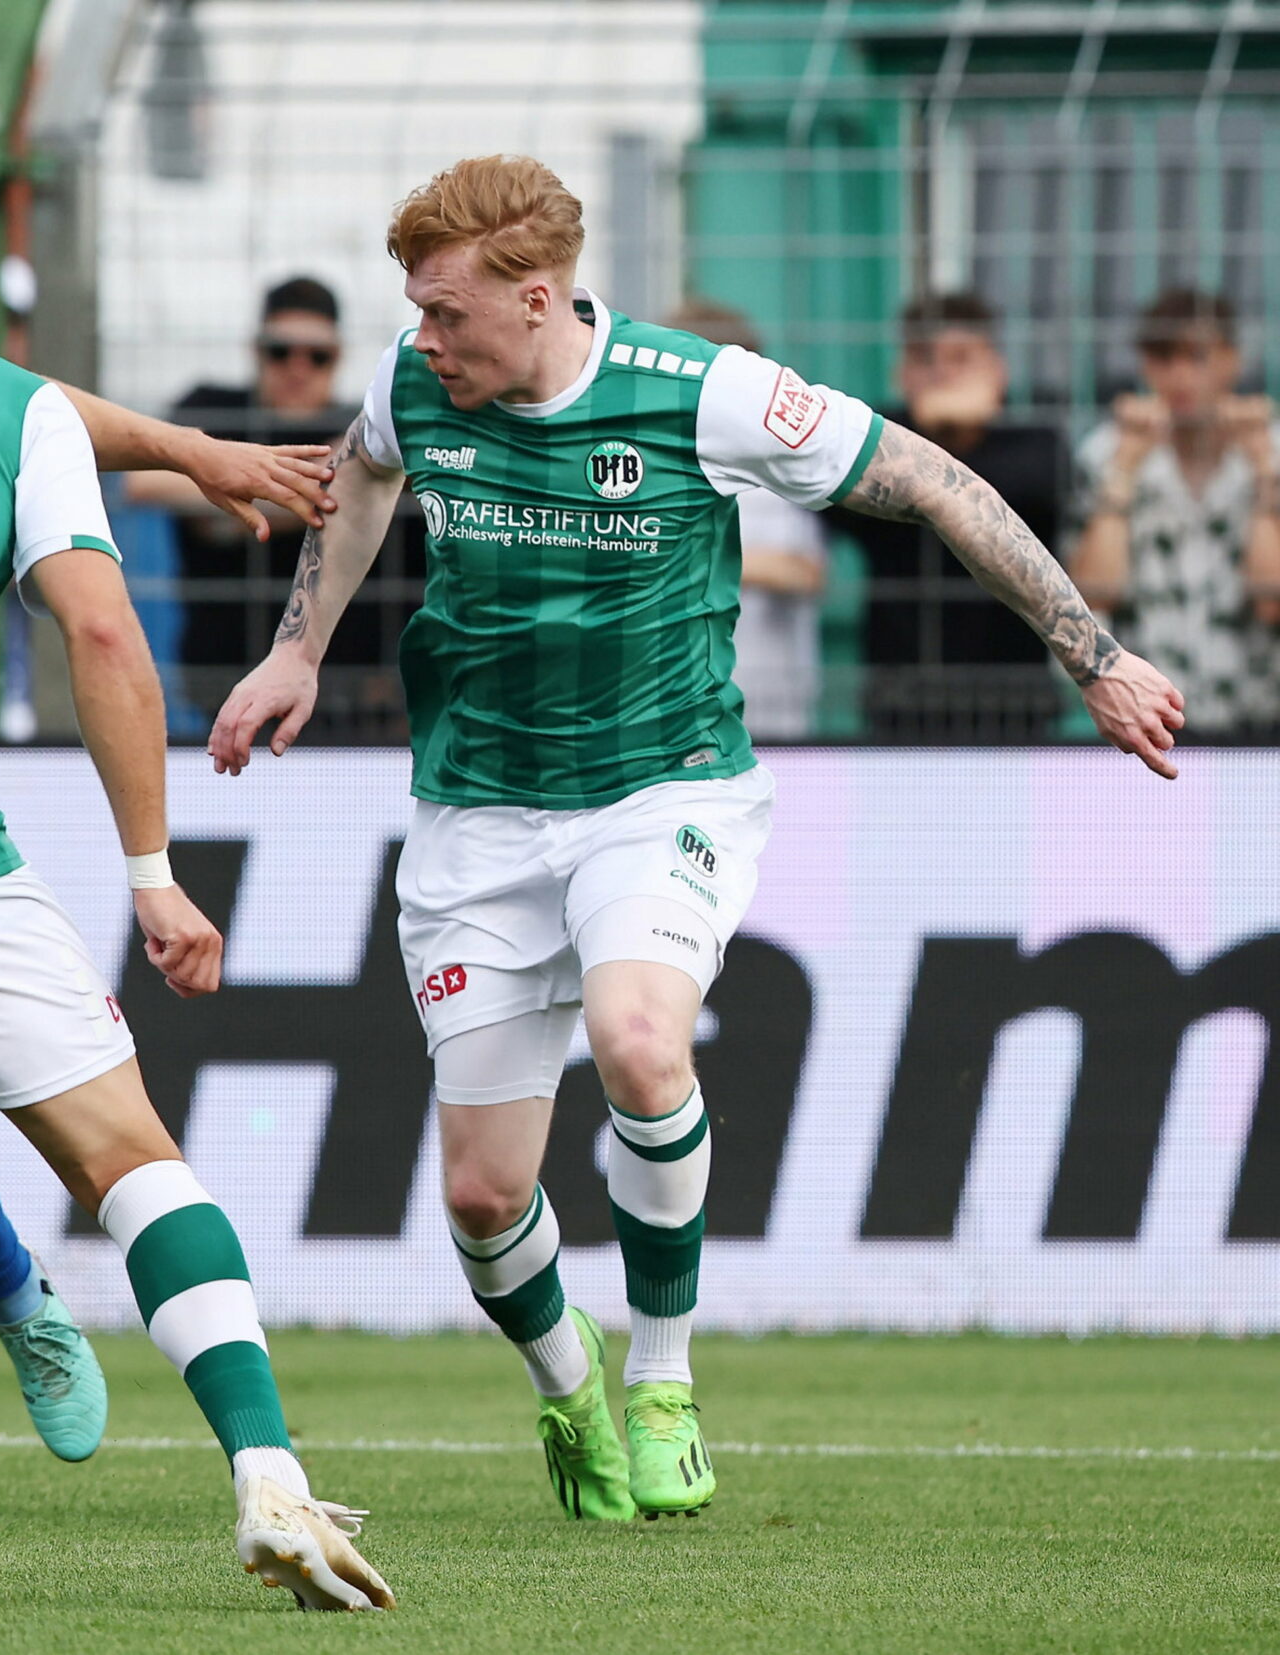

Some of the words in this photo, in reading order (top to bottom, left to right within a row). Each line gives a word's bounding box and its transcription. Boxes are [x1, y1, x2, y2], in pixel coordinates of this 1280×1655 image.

[424, 446, 477, 466] capelli
[591, 453, 639, 487] VfB
[449, 499, 662, 537] TAFELSTIFTUNG
[447, 523, 513, 546] Schleswig
[669, 868, 719, 910] capelli
[652, 928, 700, 953] capelli
